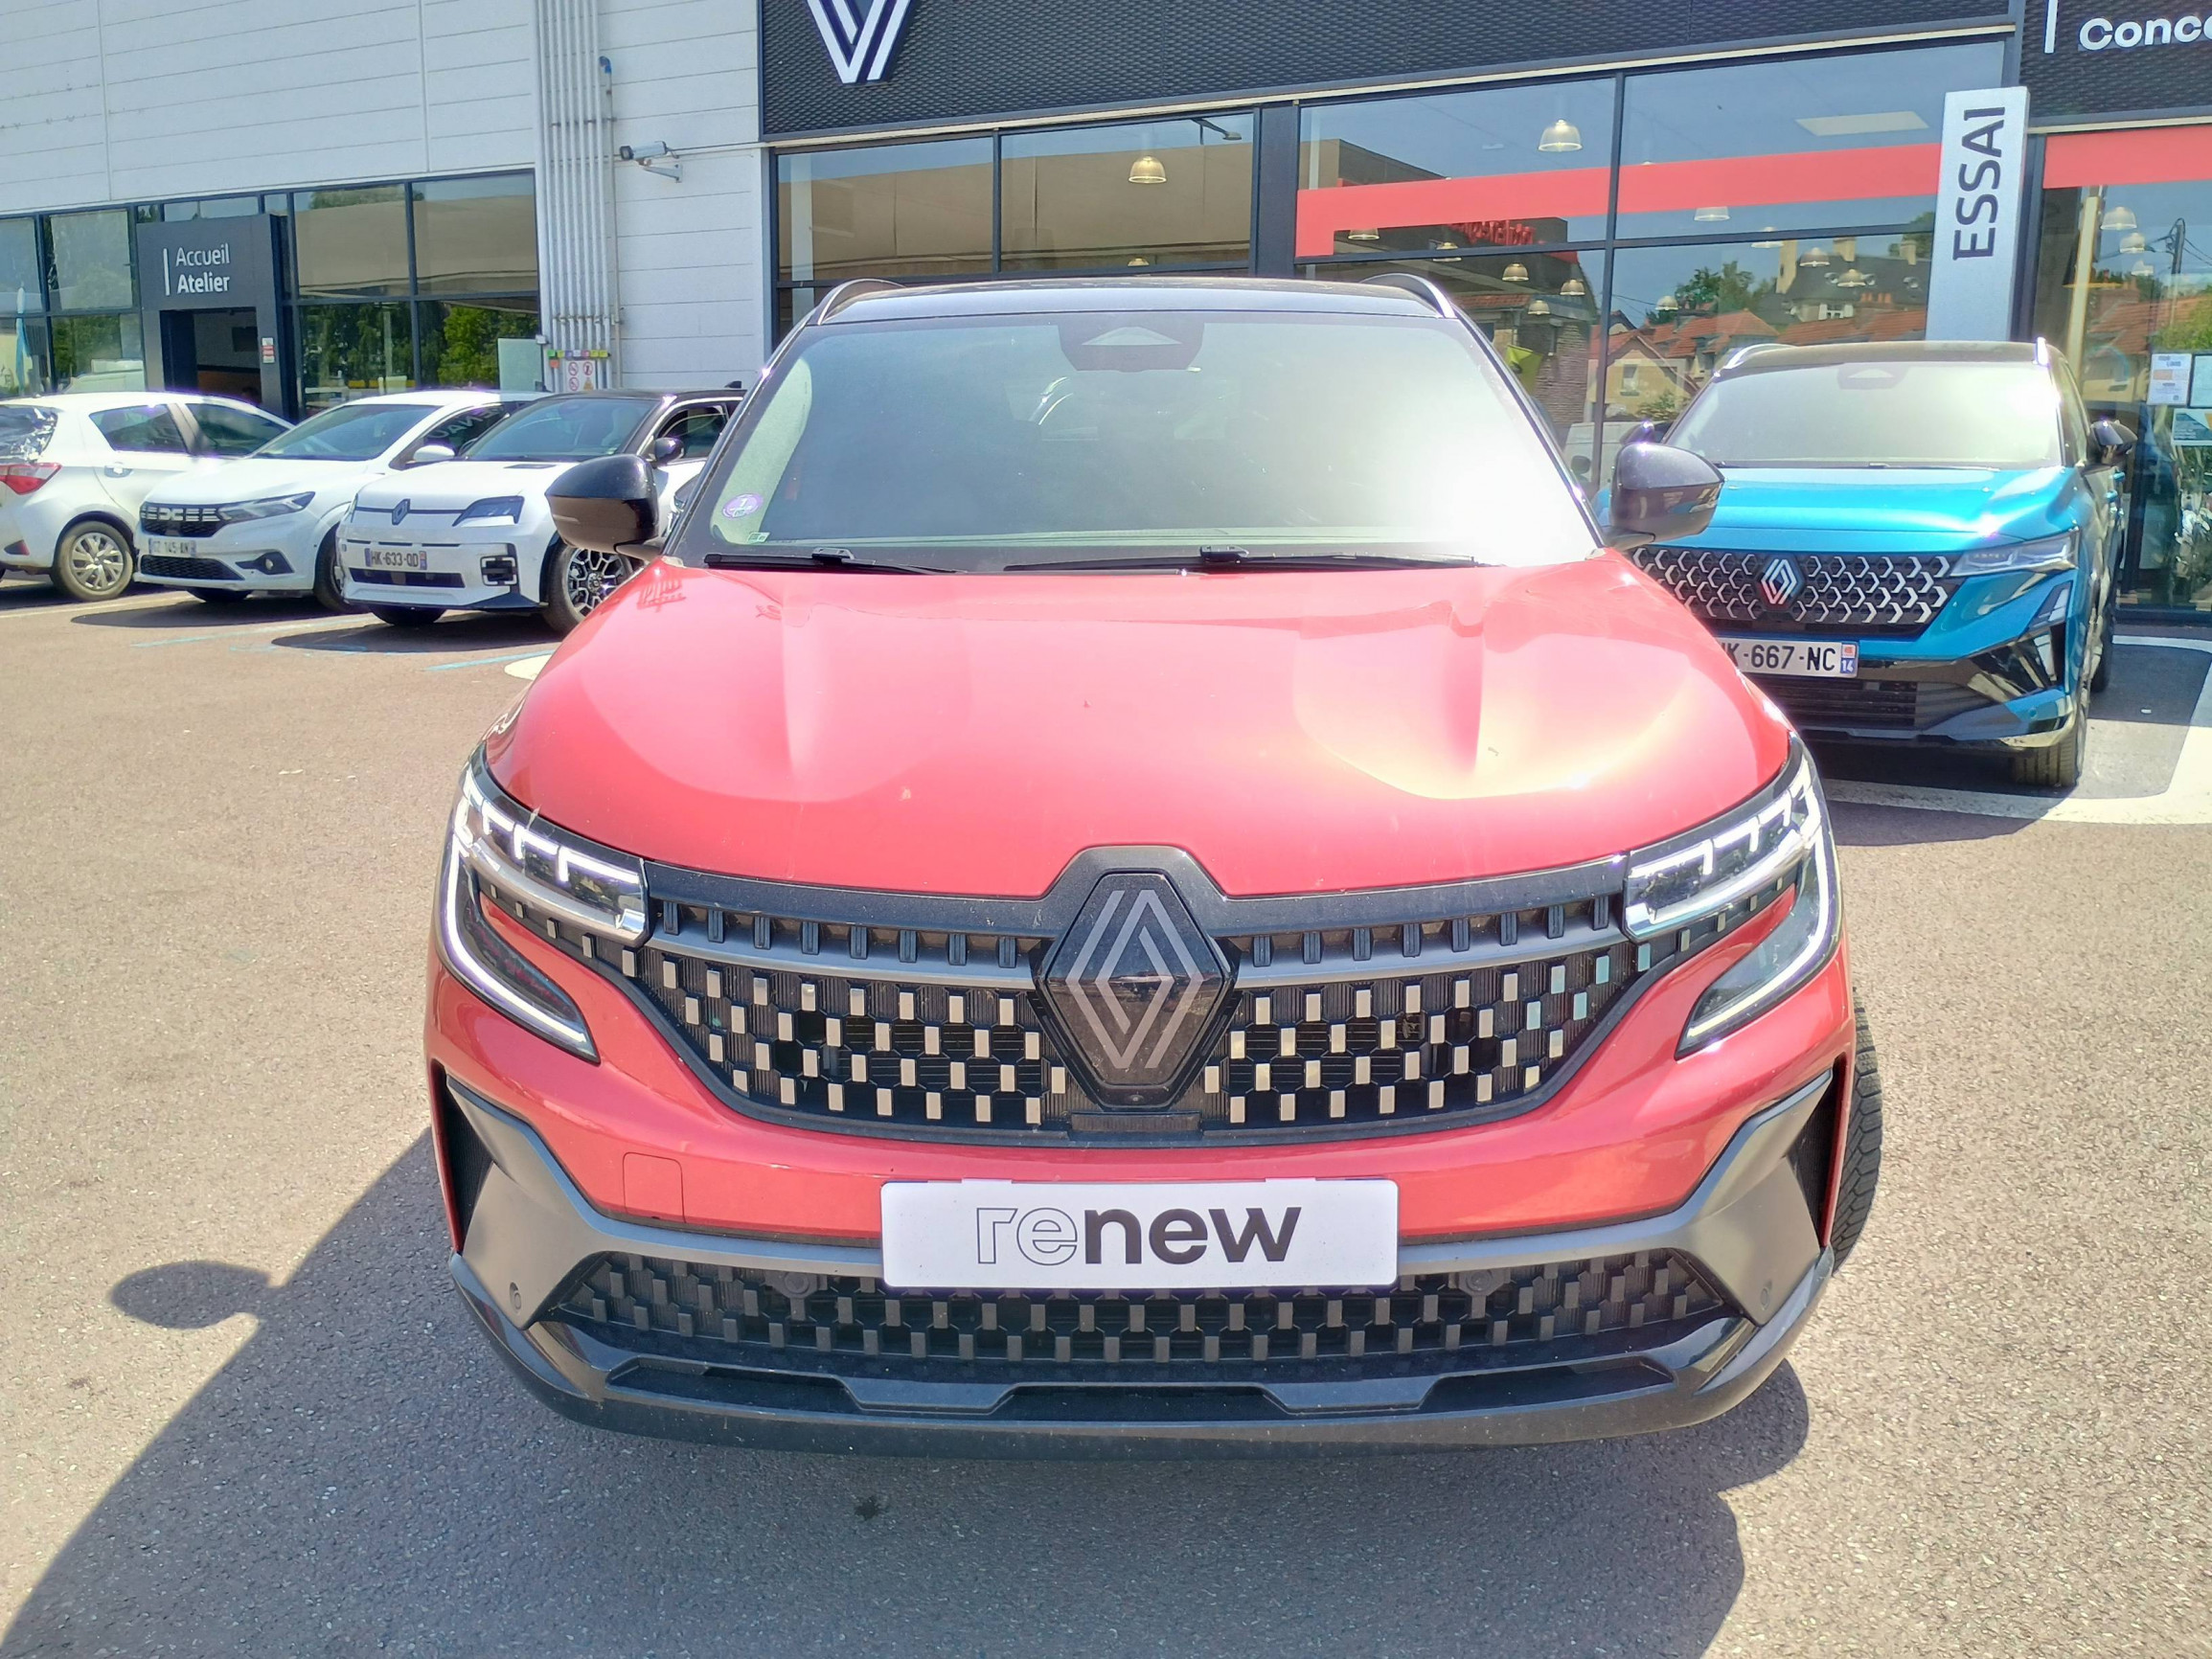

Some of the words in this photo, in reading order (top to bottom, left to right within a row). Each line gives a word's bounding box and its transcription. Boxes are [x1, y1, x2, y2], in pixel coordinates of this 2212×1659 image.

[1952, 106, 2005, 261] ESSAI
[175, 242, 230, 266] Accueil
[176, 271, 230, 294] Atelier
[1721, 642, 1836, 671] K-667-NC
[1841, 659, 1855, 672] 14
[976, 1206, 1302, 1265] renew
